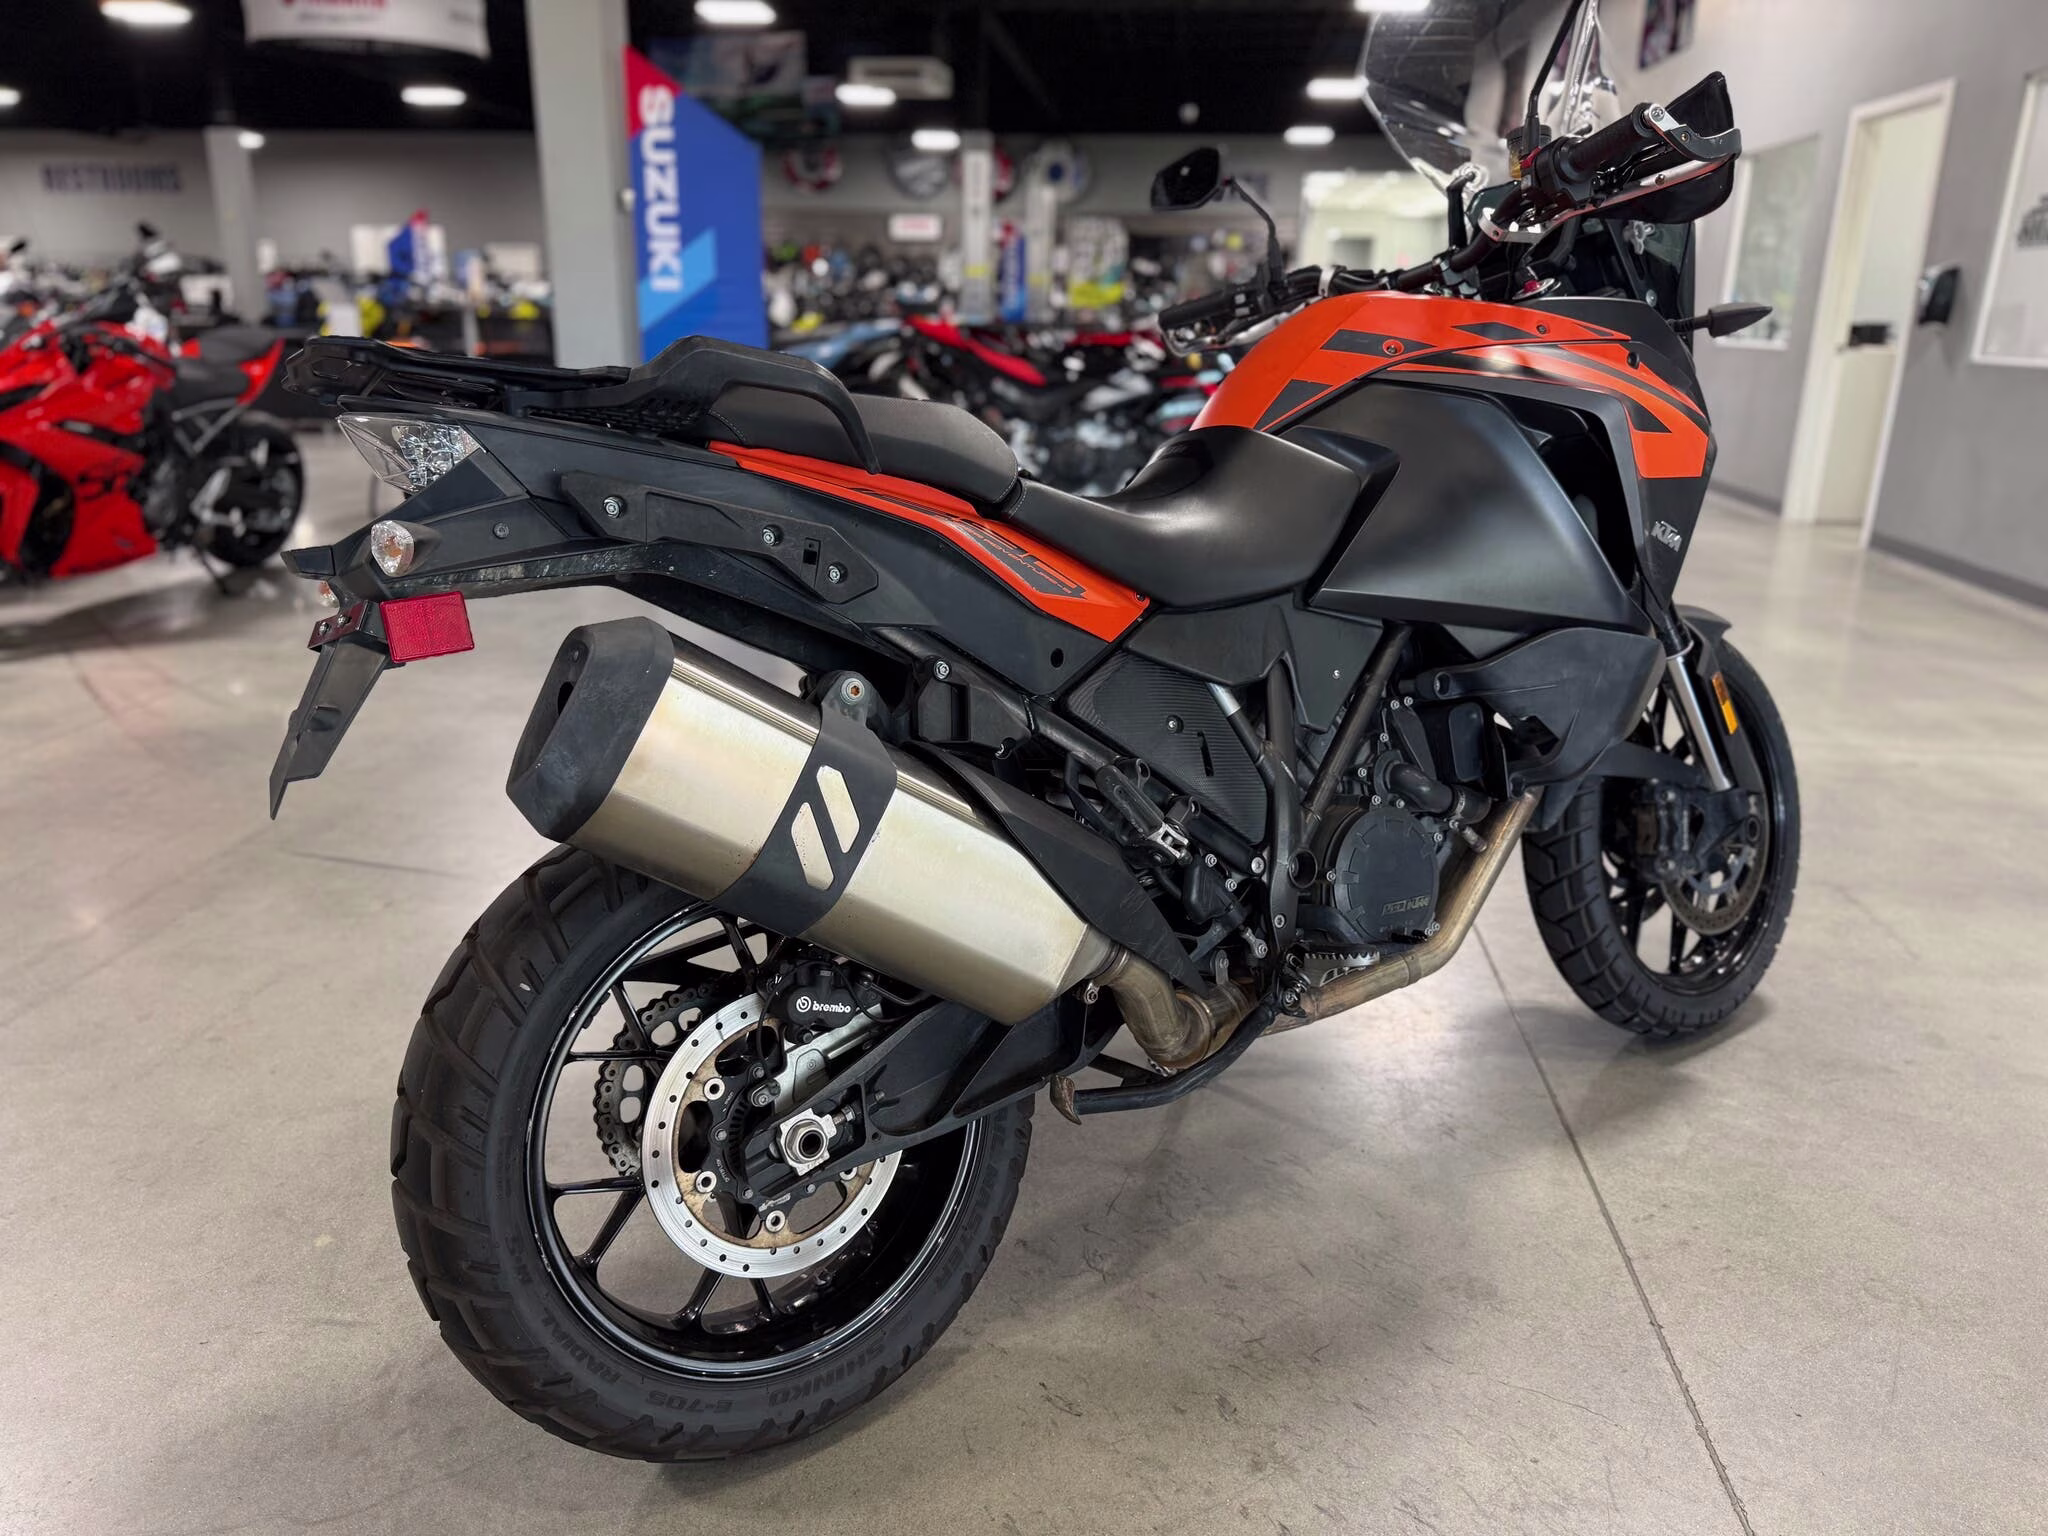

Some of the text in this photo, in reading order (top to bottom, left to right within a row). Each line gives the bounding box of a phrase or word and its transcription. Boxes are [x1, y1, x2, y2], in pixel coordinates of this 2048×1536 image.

[638, 84, 683, 292] SUZUKI
[1651, 520, 1682, 552] KTM
[812, 1000, 851, 1014] brembo
[535, 1305, 622, 1389] RADIAL
[767, 1338, 888, 1408] SHINKO
